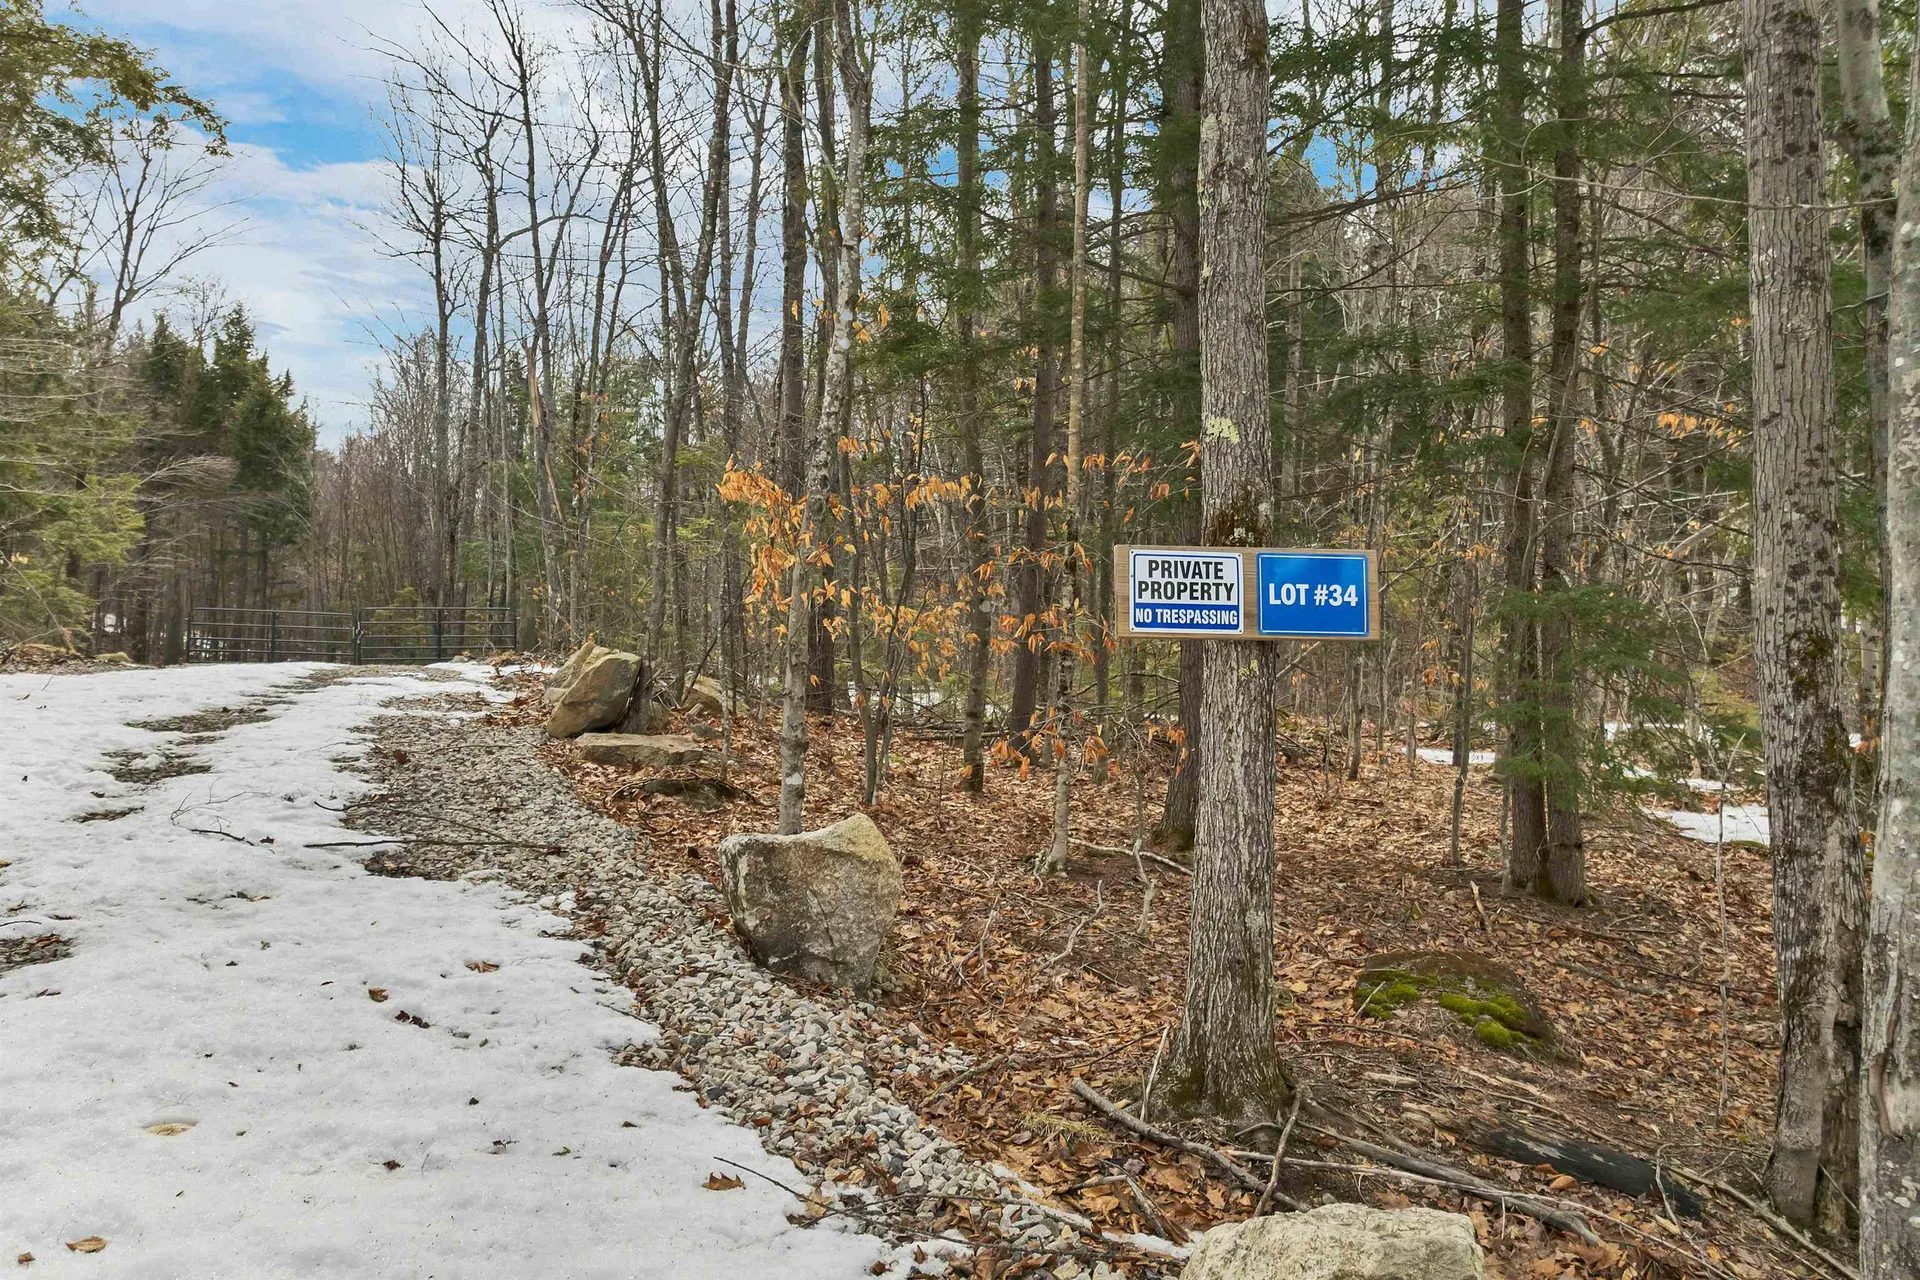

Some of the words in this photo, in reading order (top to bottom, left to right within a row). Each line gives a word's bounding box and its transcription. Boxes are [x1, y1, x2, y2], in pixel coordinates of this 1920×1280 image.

[1148, 559, 1224, 580] PRIVATE
[1137, 580, 1235, 601] PROPERTY
[1268, 583, 1310, 606] LOT
[1313, 584, 1359, 607] #34
[1135, 608, 1153, 624] NO
[1155, 608, 1239, 626] TRESPASSING
